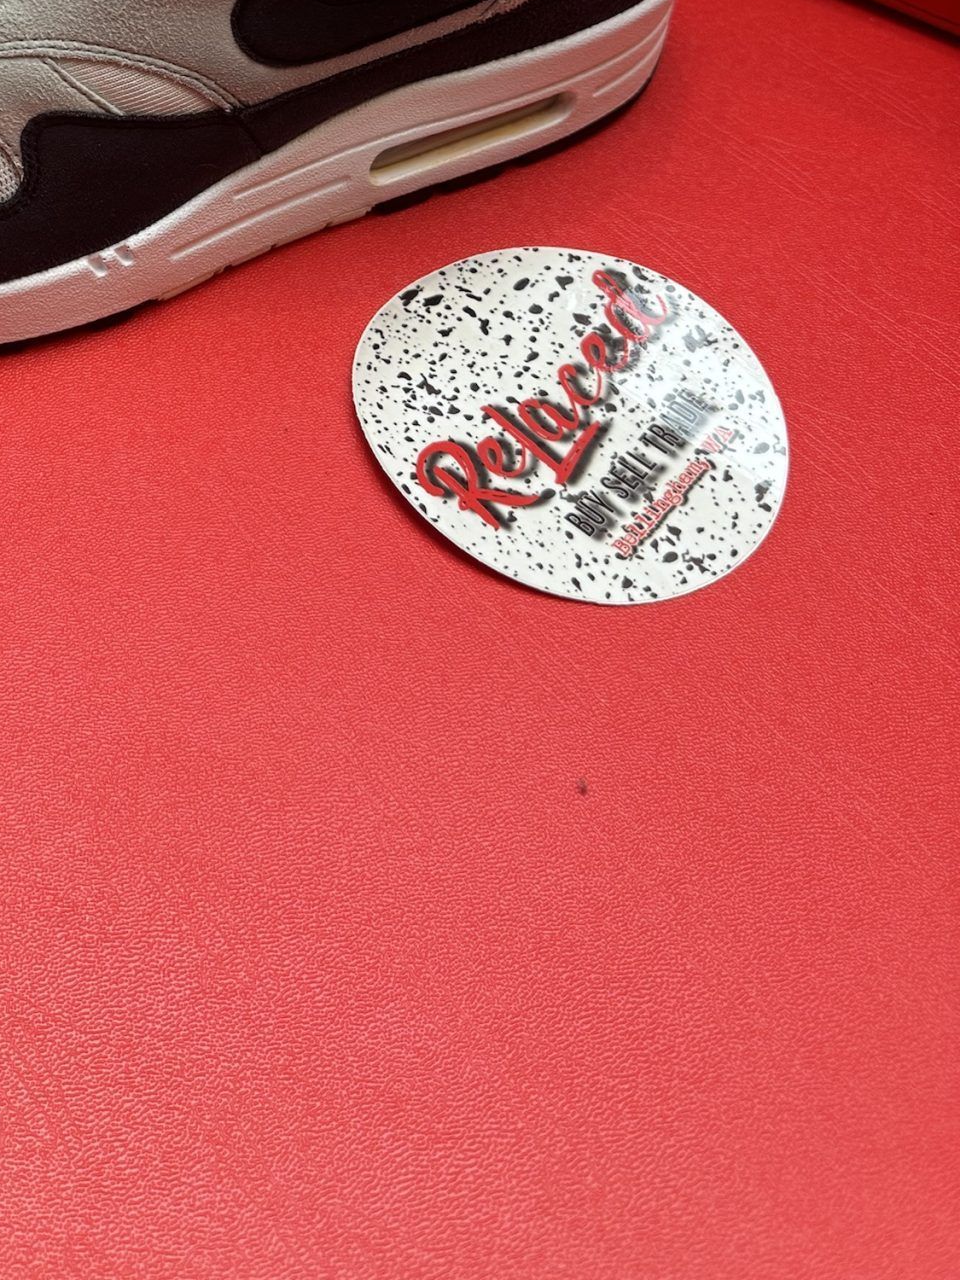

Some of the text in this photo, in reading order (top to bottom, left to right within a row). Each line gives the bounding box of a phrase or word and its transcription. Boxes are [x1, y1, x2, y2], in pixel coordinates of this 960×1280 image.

[565, 388, 709, 537] BUY SELL TRADE
